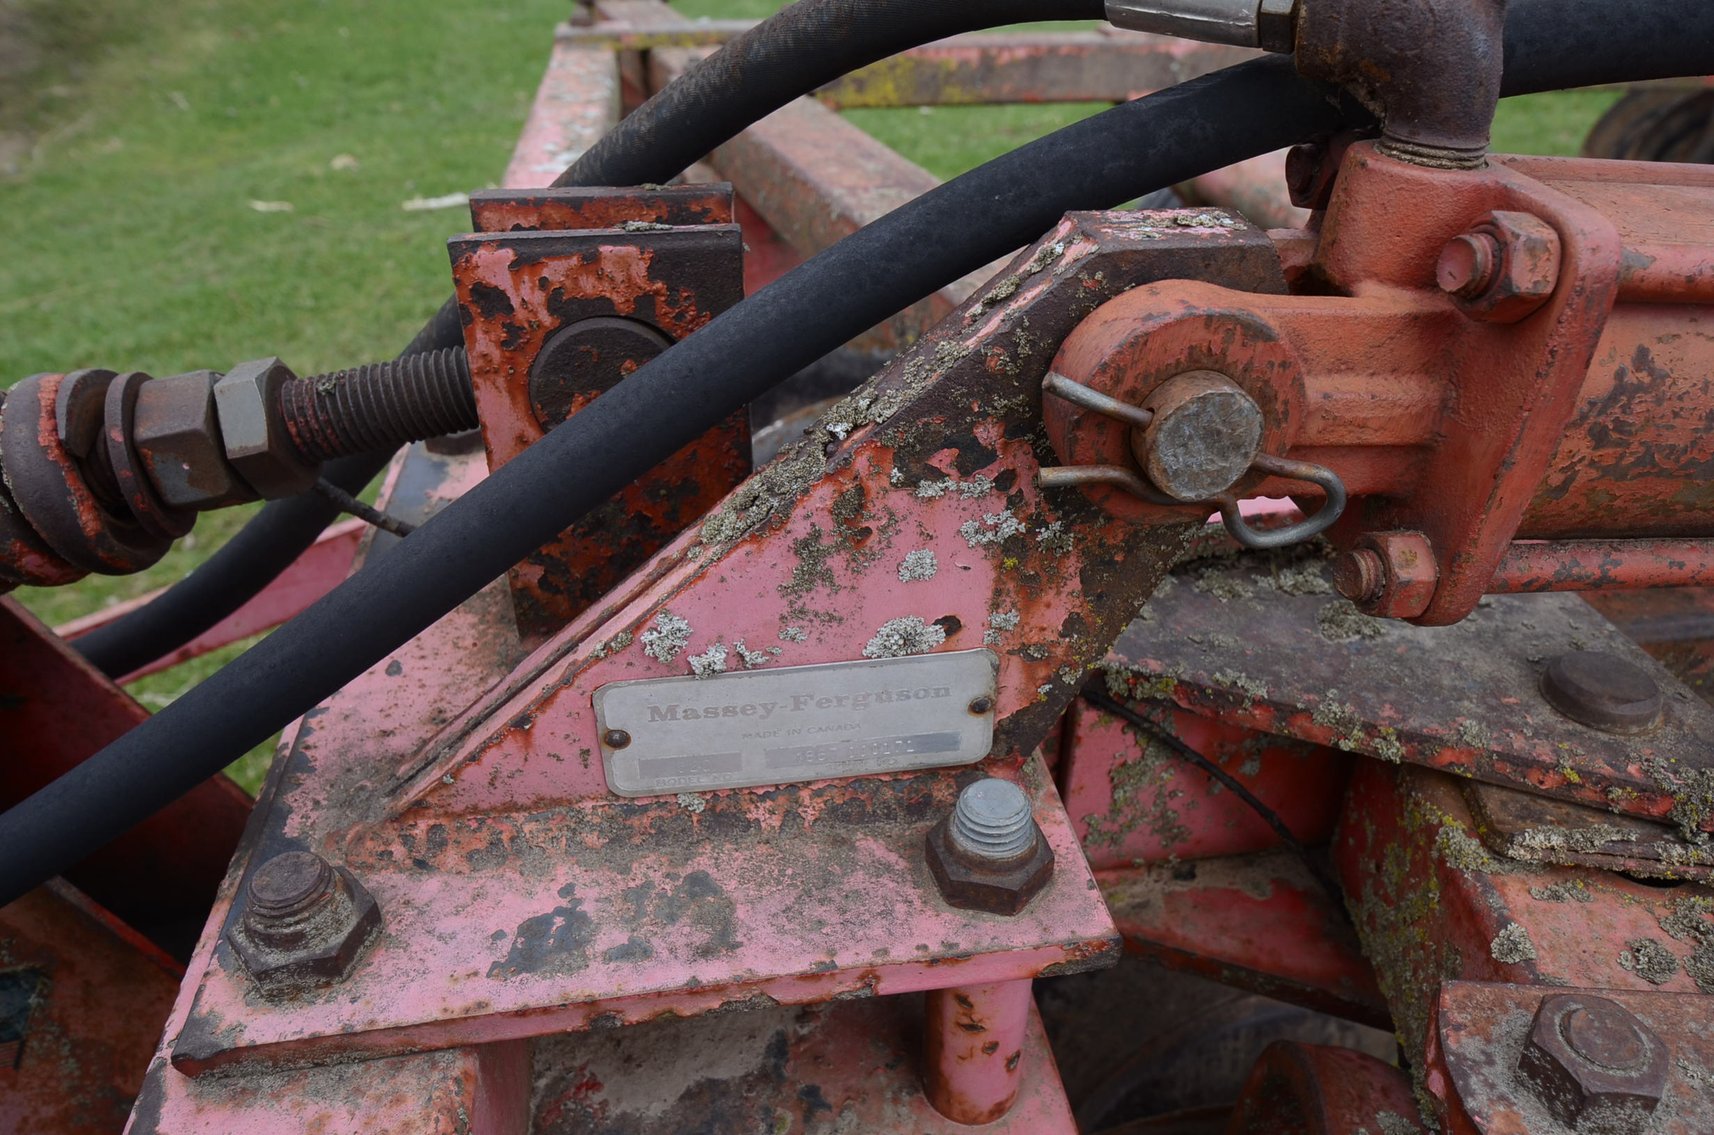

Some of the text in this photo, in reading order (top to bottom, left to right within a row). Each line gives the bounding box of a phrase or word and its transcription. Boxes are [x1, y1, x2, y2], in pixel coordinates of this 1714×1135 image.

[647, 685, 953, 723] Massey-Ferguson
[741, 720, 861, 739] MADE IN CANADA
